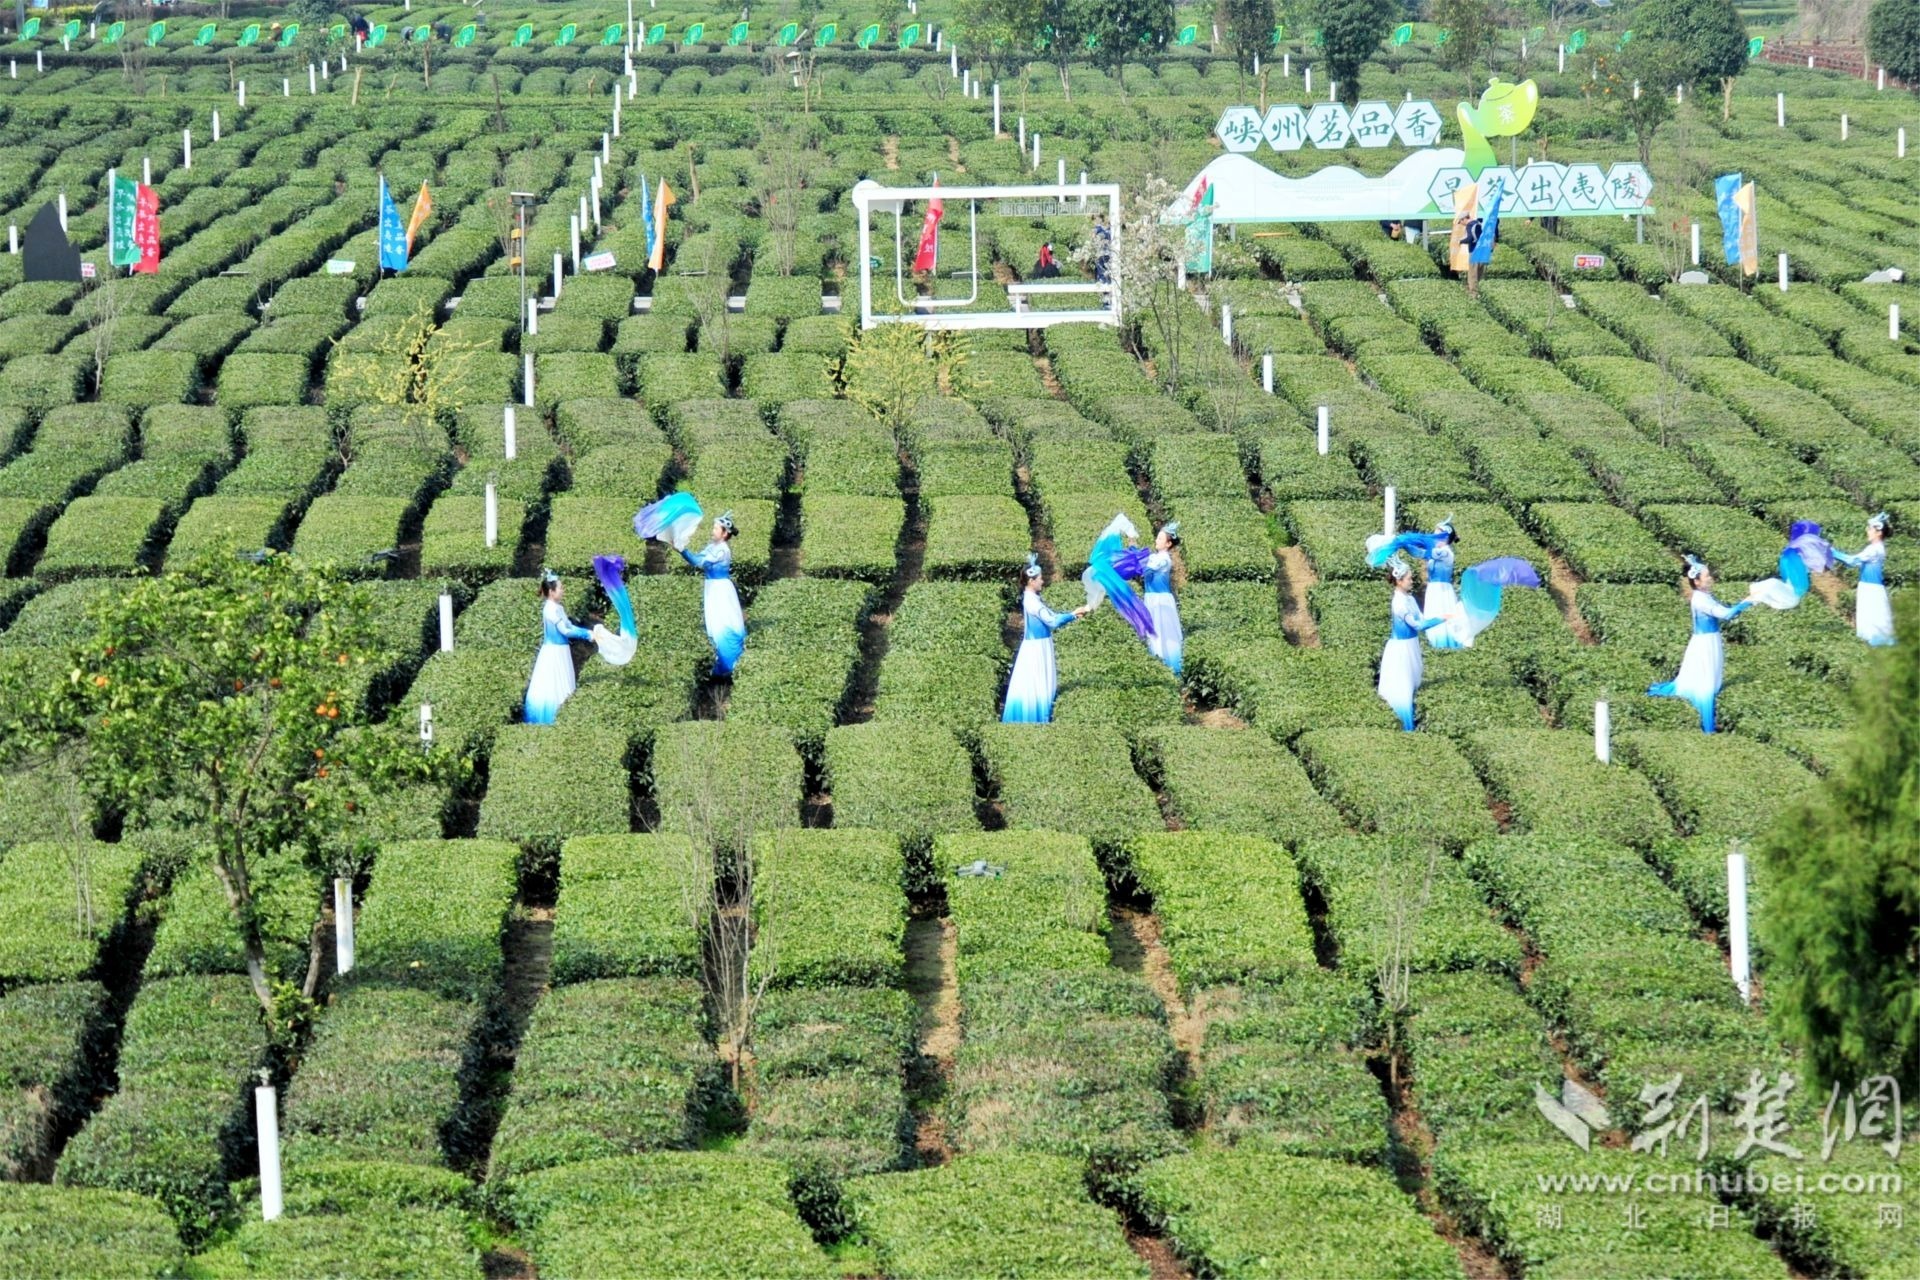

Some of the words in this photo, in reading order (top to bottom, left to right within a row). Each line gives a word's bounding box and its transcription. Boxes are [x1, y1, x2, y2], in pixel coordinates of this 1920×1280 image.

[1224, 108, 1437, 145] 峡州茗品香
[1438, 172, 1643, 206] 早茶出夷陵
